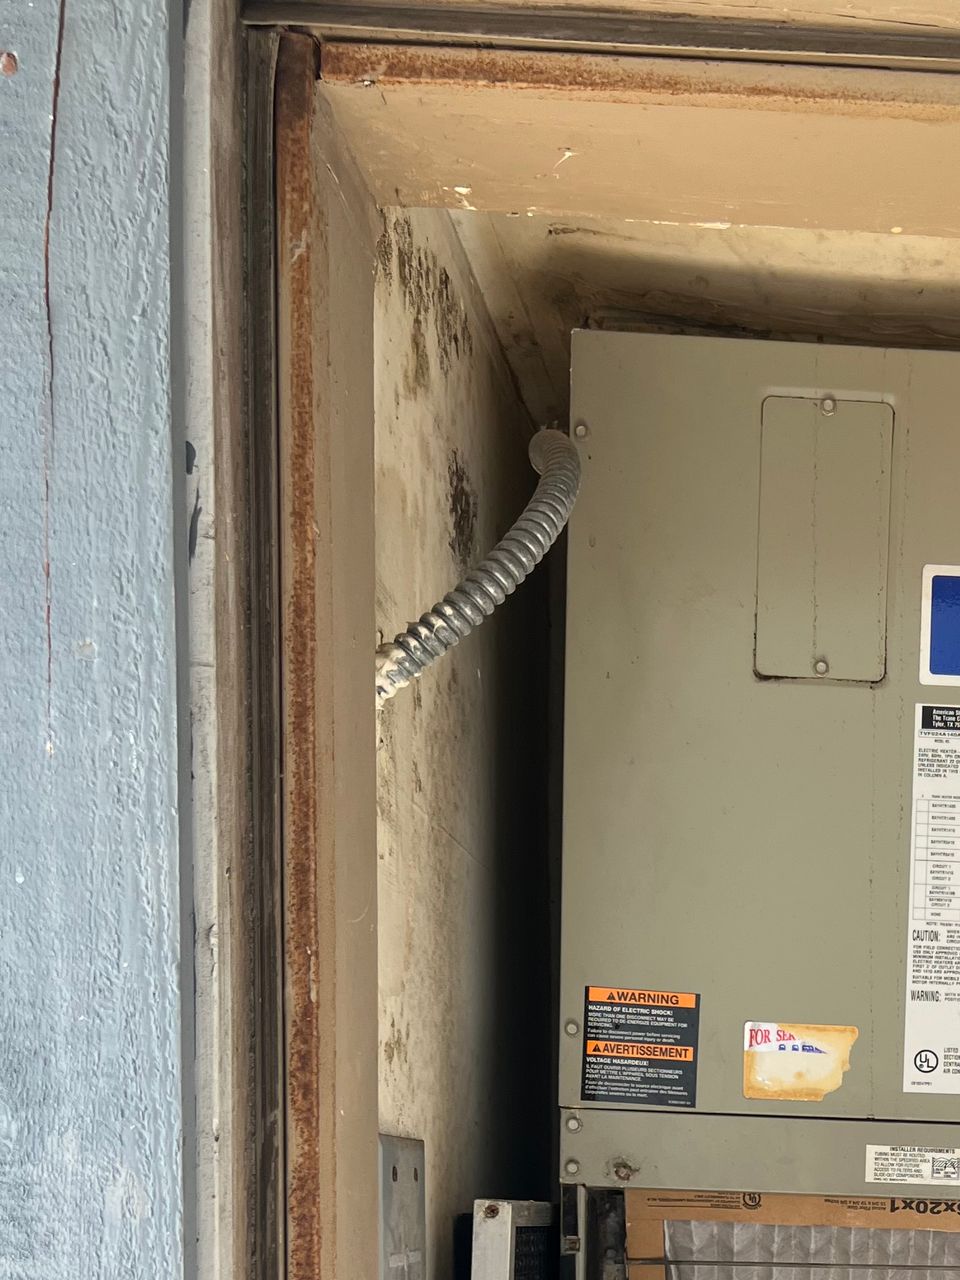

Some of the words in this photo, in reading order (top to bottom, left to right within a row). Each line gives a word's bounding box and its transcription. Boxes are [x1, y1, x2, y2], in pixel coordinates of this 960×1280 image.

[913, 929, 941, 942] CAUTION:
[617, 991, 679, 1004] WARNING
[910, 990, 942, 1002] WARNING:
[749, 1029, 771, 1048] FOR
[603, 1043, 689, 1058] AVERTISSEMENT
[920, 1054, 934, 1068] UL
